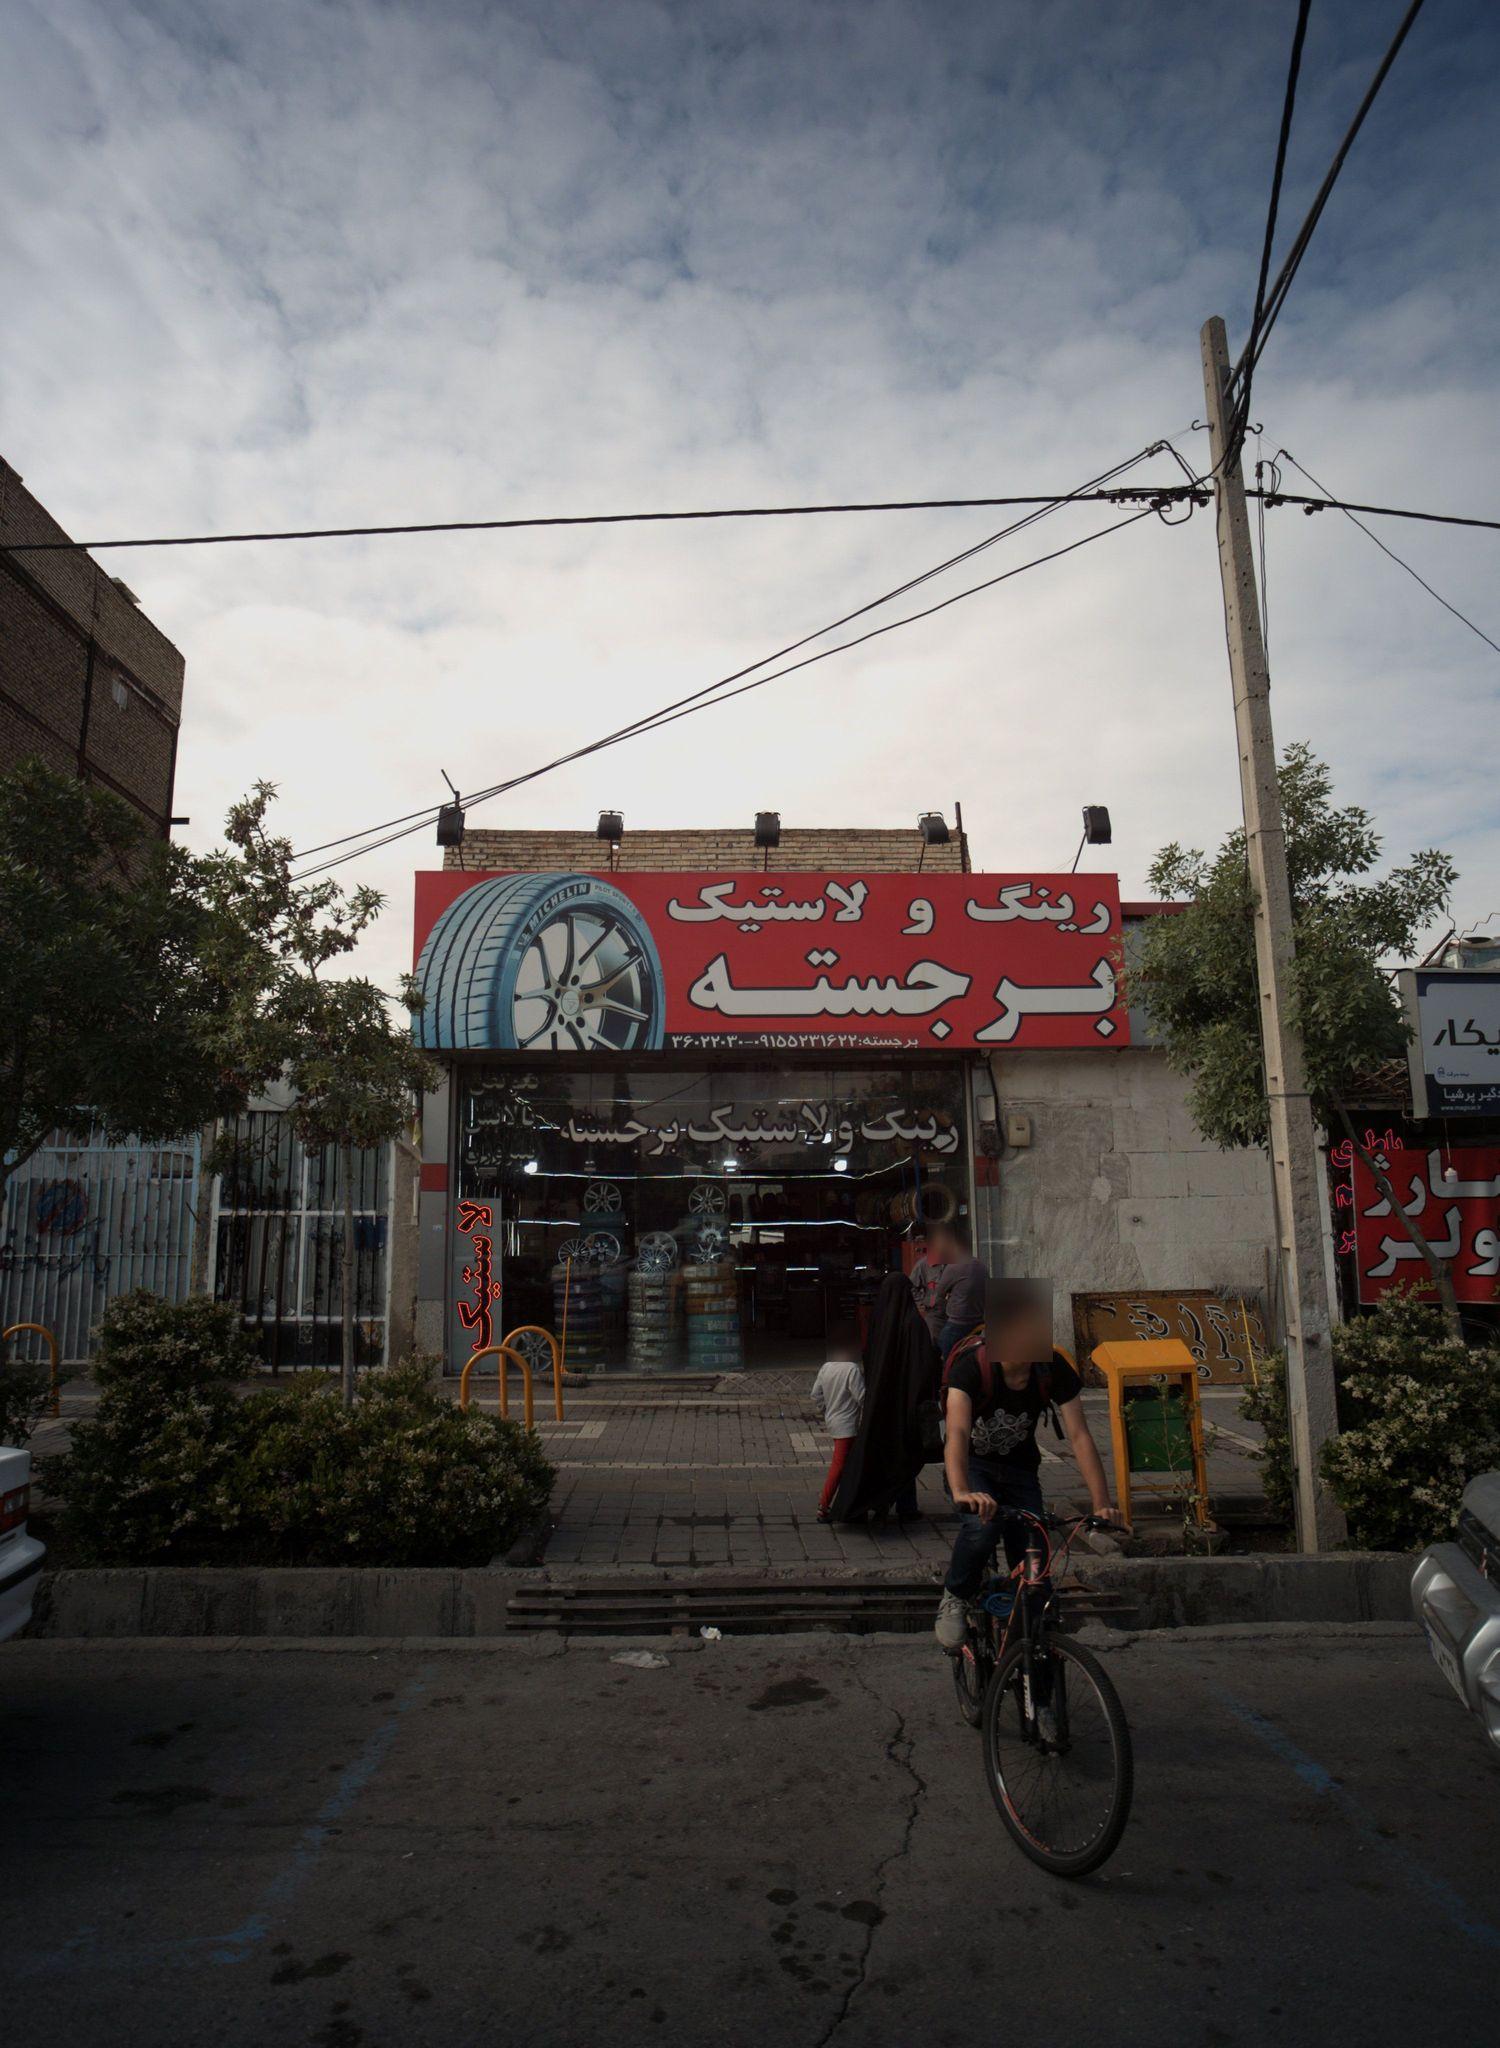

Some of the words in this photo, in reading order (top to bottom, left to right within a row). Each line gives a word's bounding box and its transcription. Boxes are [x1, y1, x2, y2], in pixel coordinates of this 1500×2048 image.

[529, 883, 588, 932] MICHELIN
[667, 880, 868, 933] لاستیک
[901, 898, 937, 935] و
[966, 881, 1110, 935] رینگ
[688, 947, 1118, 1042] برجسته
[1443, 1087, 1476, 1104] پرشیا
[687, 1101, 831, 1152] لاستیک
[835, 1119, 855, 1153] و
[1362, 1147, 1500, 1217] ارژ
[1366, 1205, 1500, 1277] ولر
[457, 1201, 501, 1351] لاستیک
[1204, 1303, 1245, 1374] اتومبیل
